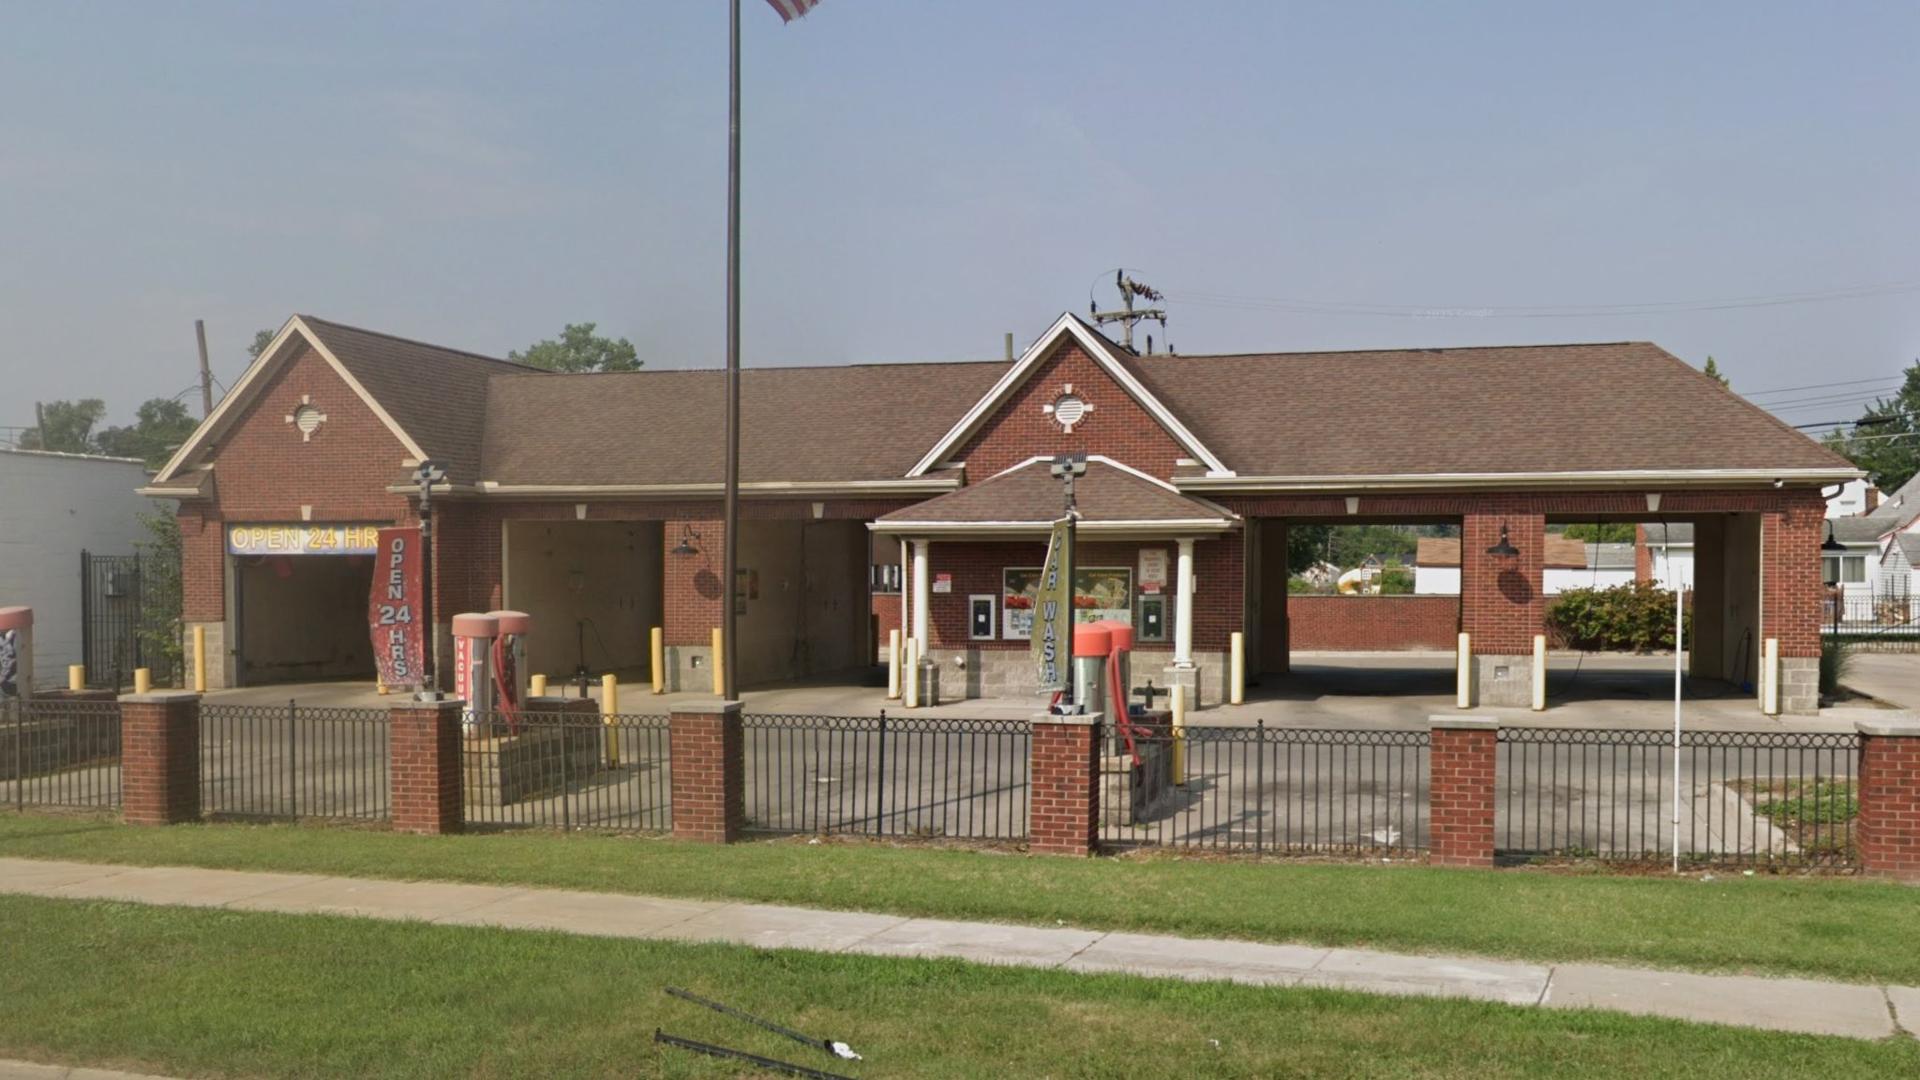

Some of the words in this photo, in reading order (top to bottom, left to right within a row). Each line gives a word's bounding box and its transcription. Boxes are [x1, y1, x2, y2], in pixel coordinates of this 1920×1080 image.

[231, 527, 300, 549] OPEN
[308, 527, 338, 549] 24
[344, 526, 380, 549] HR
[388, 538, 404, 599] OPEN
[379, 605, 411, 625] 24
[389, 630, 407, 676] HRS
[1042, 601, 1058, 683] WASH
